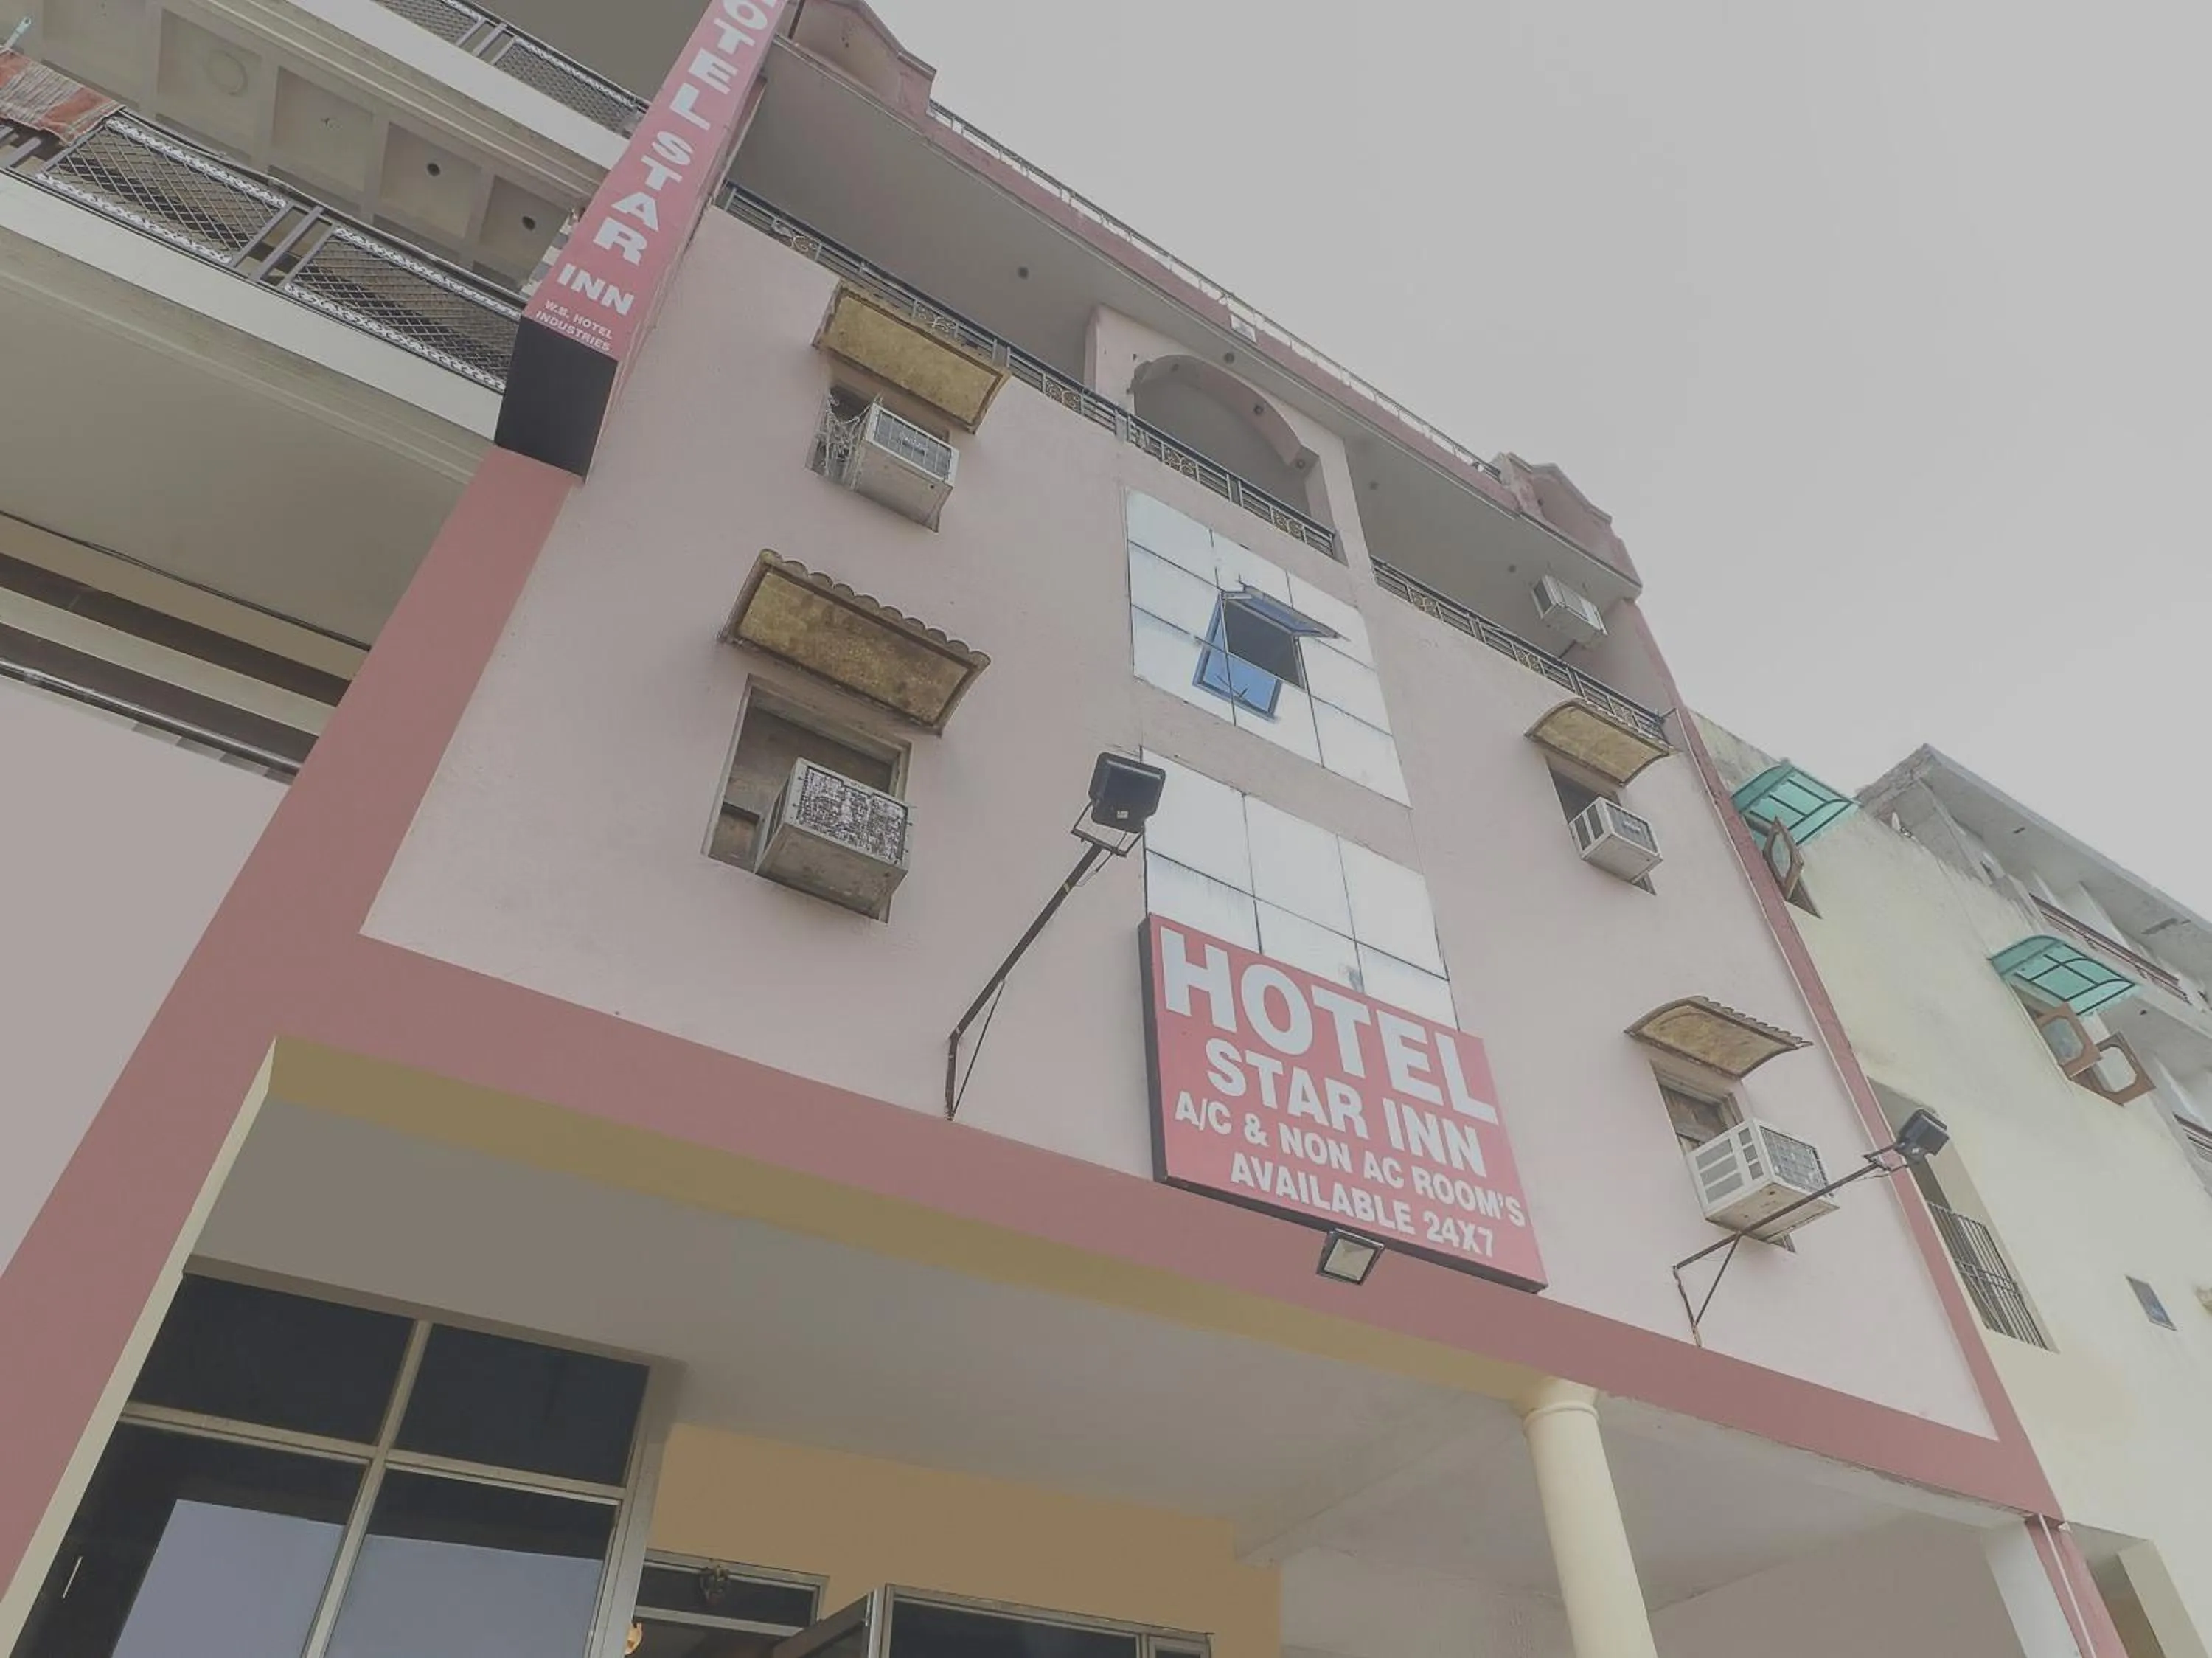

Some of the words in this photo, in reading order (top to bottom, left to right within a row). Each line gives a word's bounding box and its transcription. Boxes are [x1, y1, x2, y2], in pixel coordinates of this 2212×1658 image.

[669, 0, 776, 131] OTEL
[593, 131, 695, 266] STAR
[536, 311, 611, 351] INDUSTRIES
[557, 263, 635, 316] INN
[573, 313, 613, 340] HOTEL
[1160, 927, 1499, 1125] HOTEL
[1175, 1091, 1232, 1134] A/C
[1244, 1113, 1270, 1147] &
[1279, 1123, 1352, 1173] NON
[1363, 1151, 1404, 1189] AC
[1411, 1165, 1526, 1227] ROOM'S
[1206, 1038, 1370, 1139] STAR
[1382, 1098, 1486, 1178] INN
[1231, 1152, 1416, 1235] AVAILABLE
[1423, 1210, 1494, 1258] 24X7
